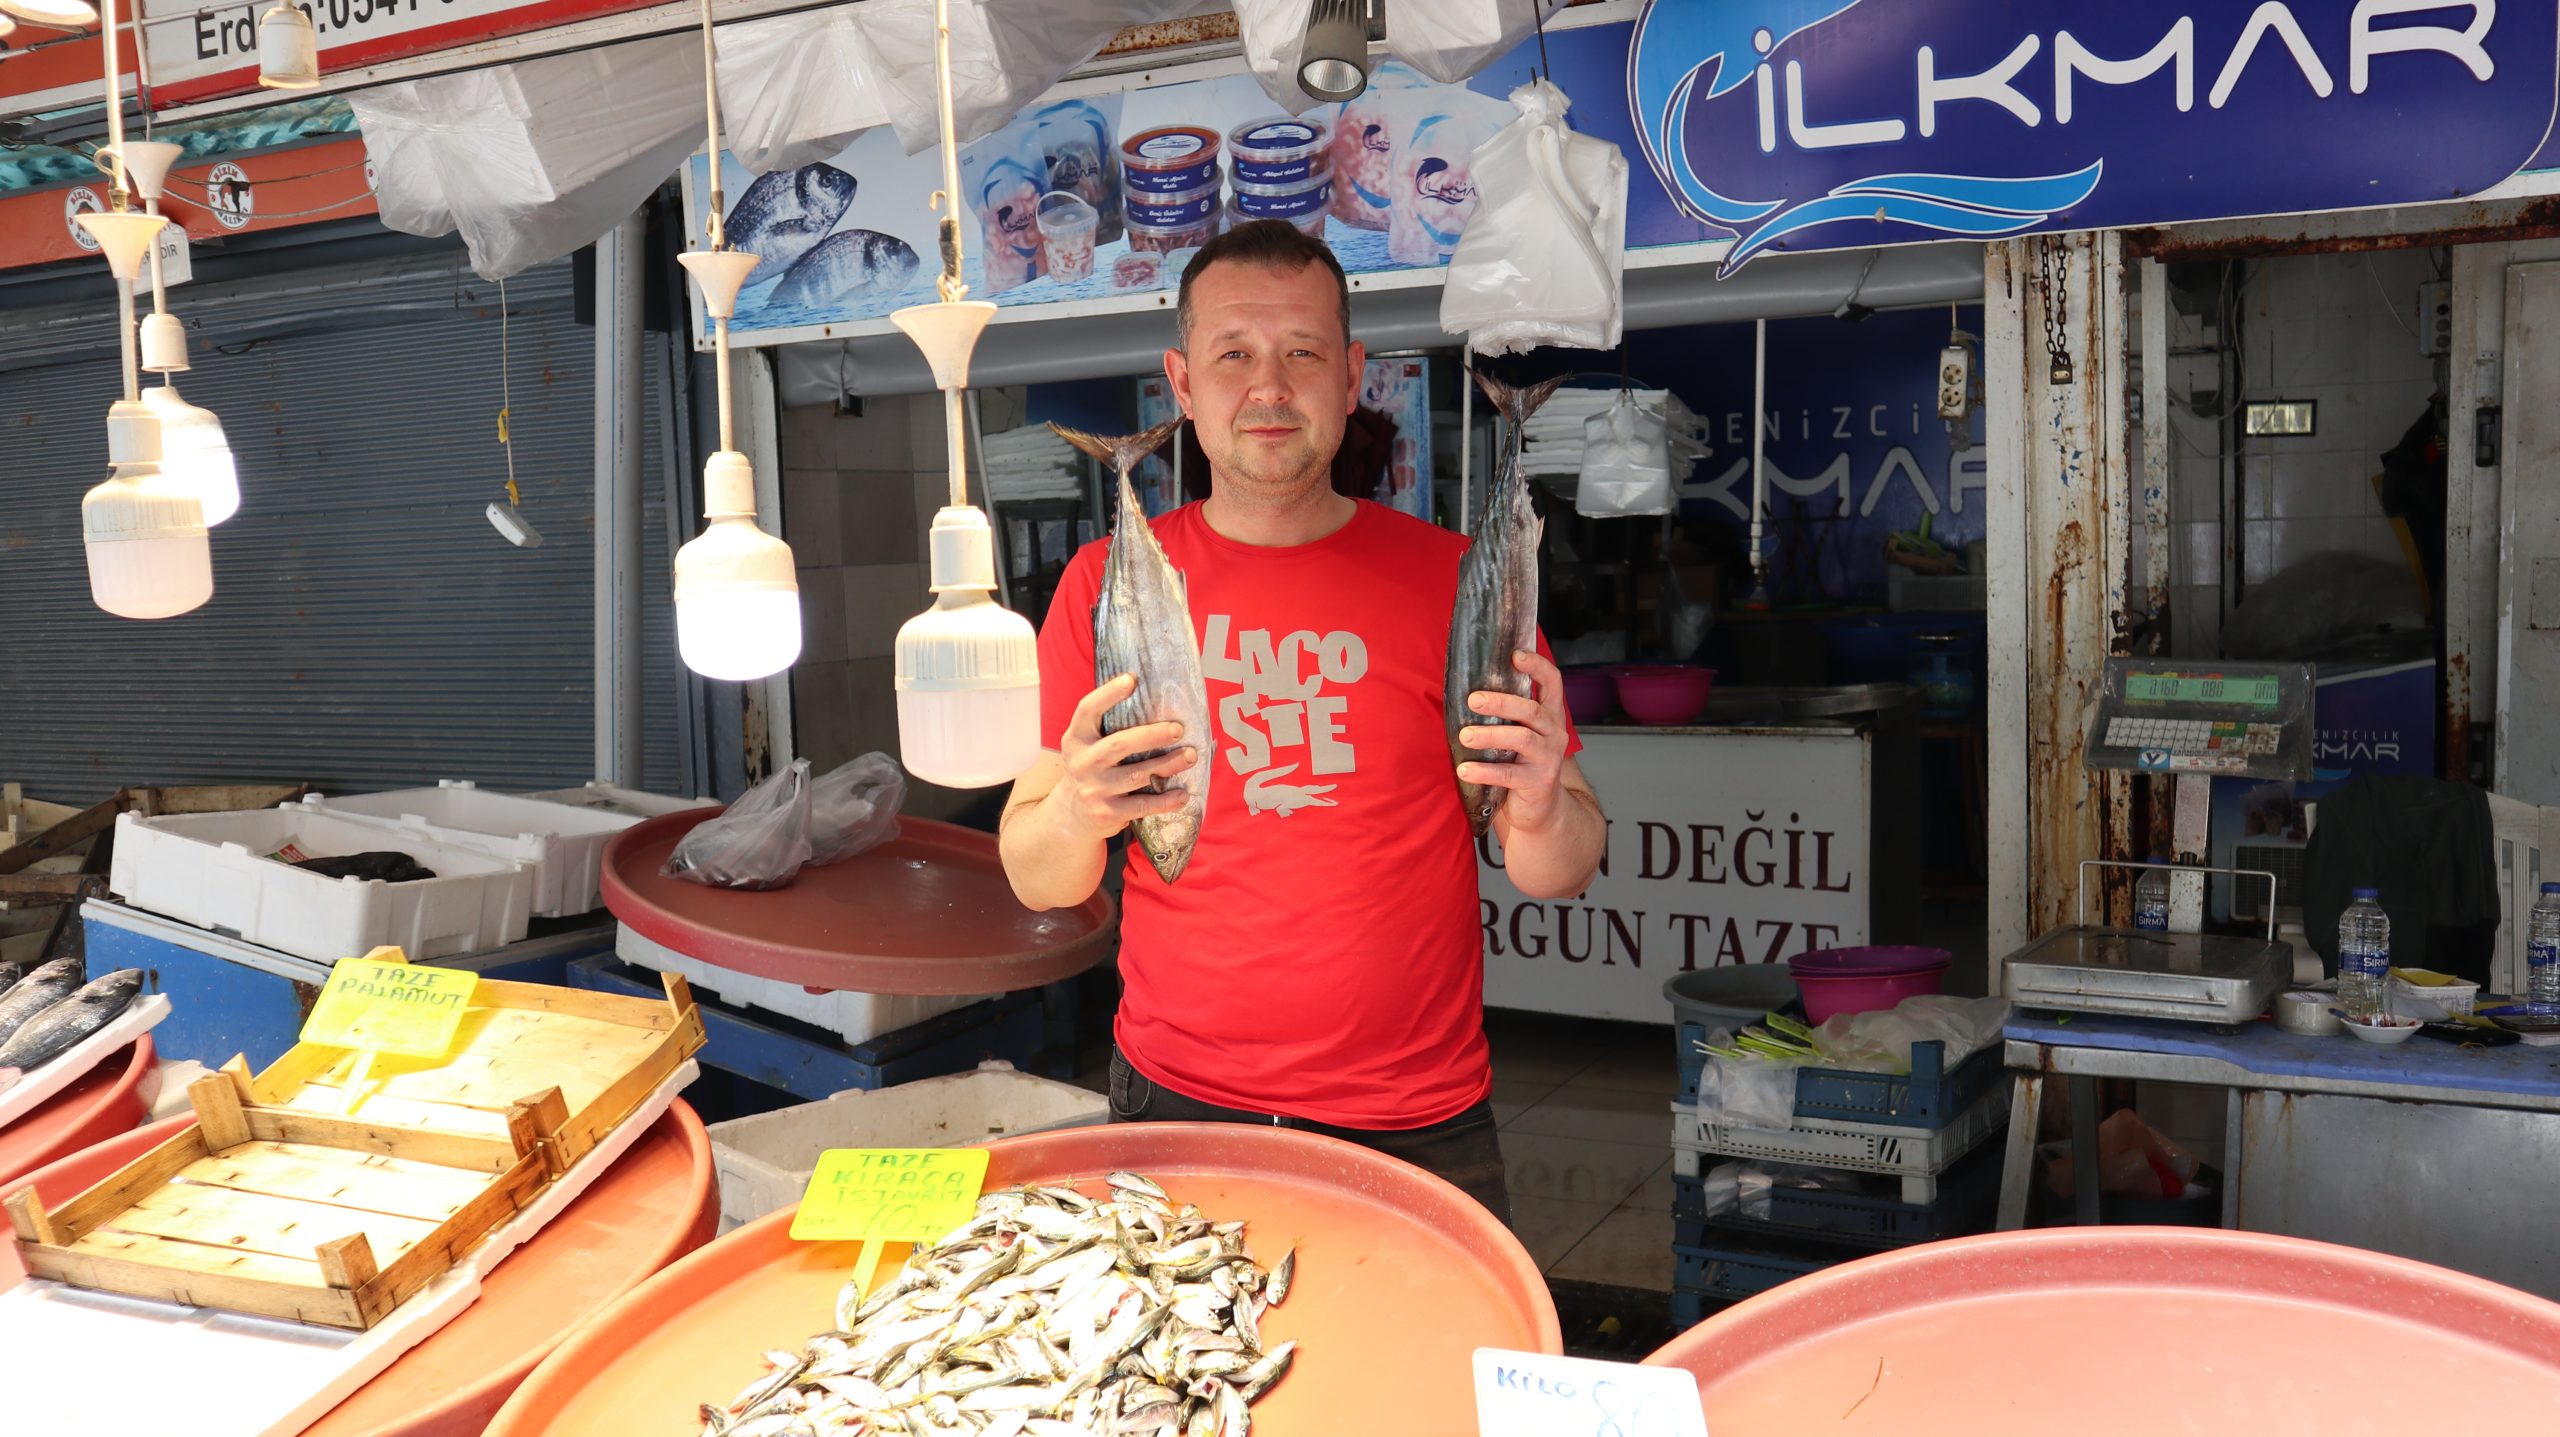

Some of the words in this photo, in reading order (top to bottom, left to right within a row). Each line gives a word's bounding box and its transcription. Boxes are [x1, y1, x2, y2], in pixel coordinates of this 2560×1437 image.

[1753, 0, 2496, 153] İLKMAR
[213, 166, 239, 182] BİZİM
[1423, 178, 1478, 197] İLKMA
[1201, 614, 1369, 702] LACO
[1218, 692, 1356, 776] STE
[1636, 808, 1852, 894] DEĞİL
[2138, 915, 2167, 927] SIRMA
[373, 967, 444, 987] TAZE
[859, 1154, 943, 1168] TAZE
